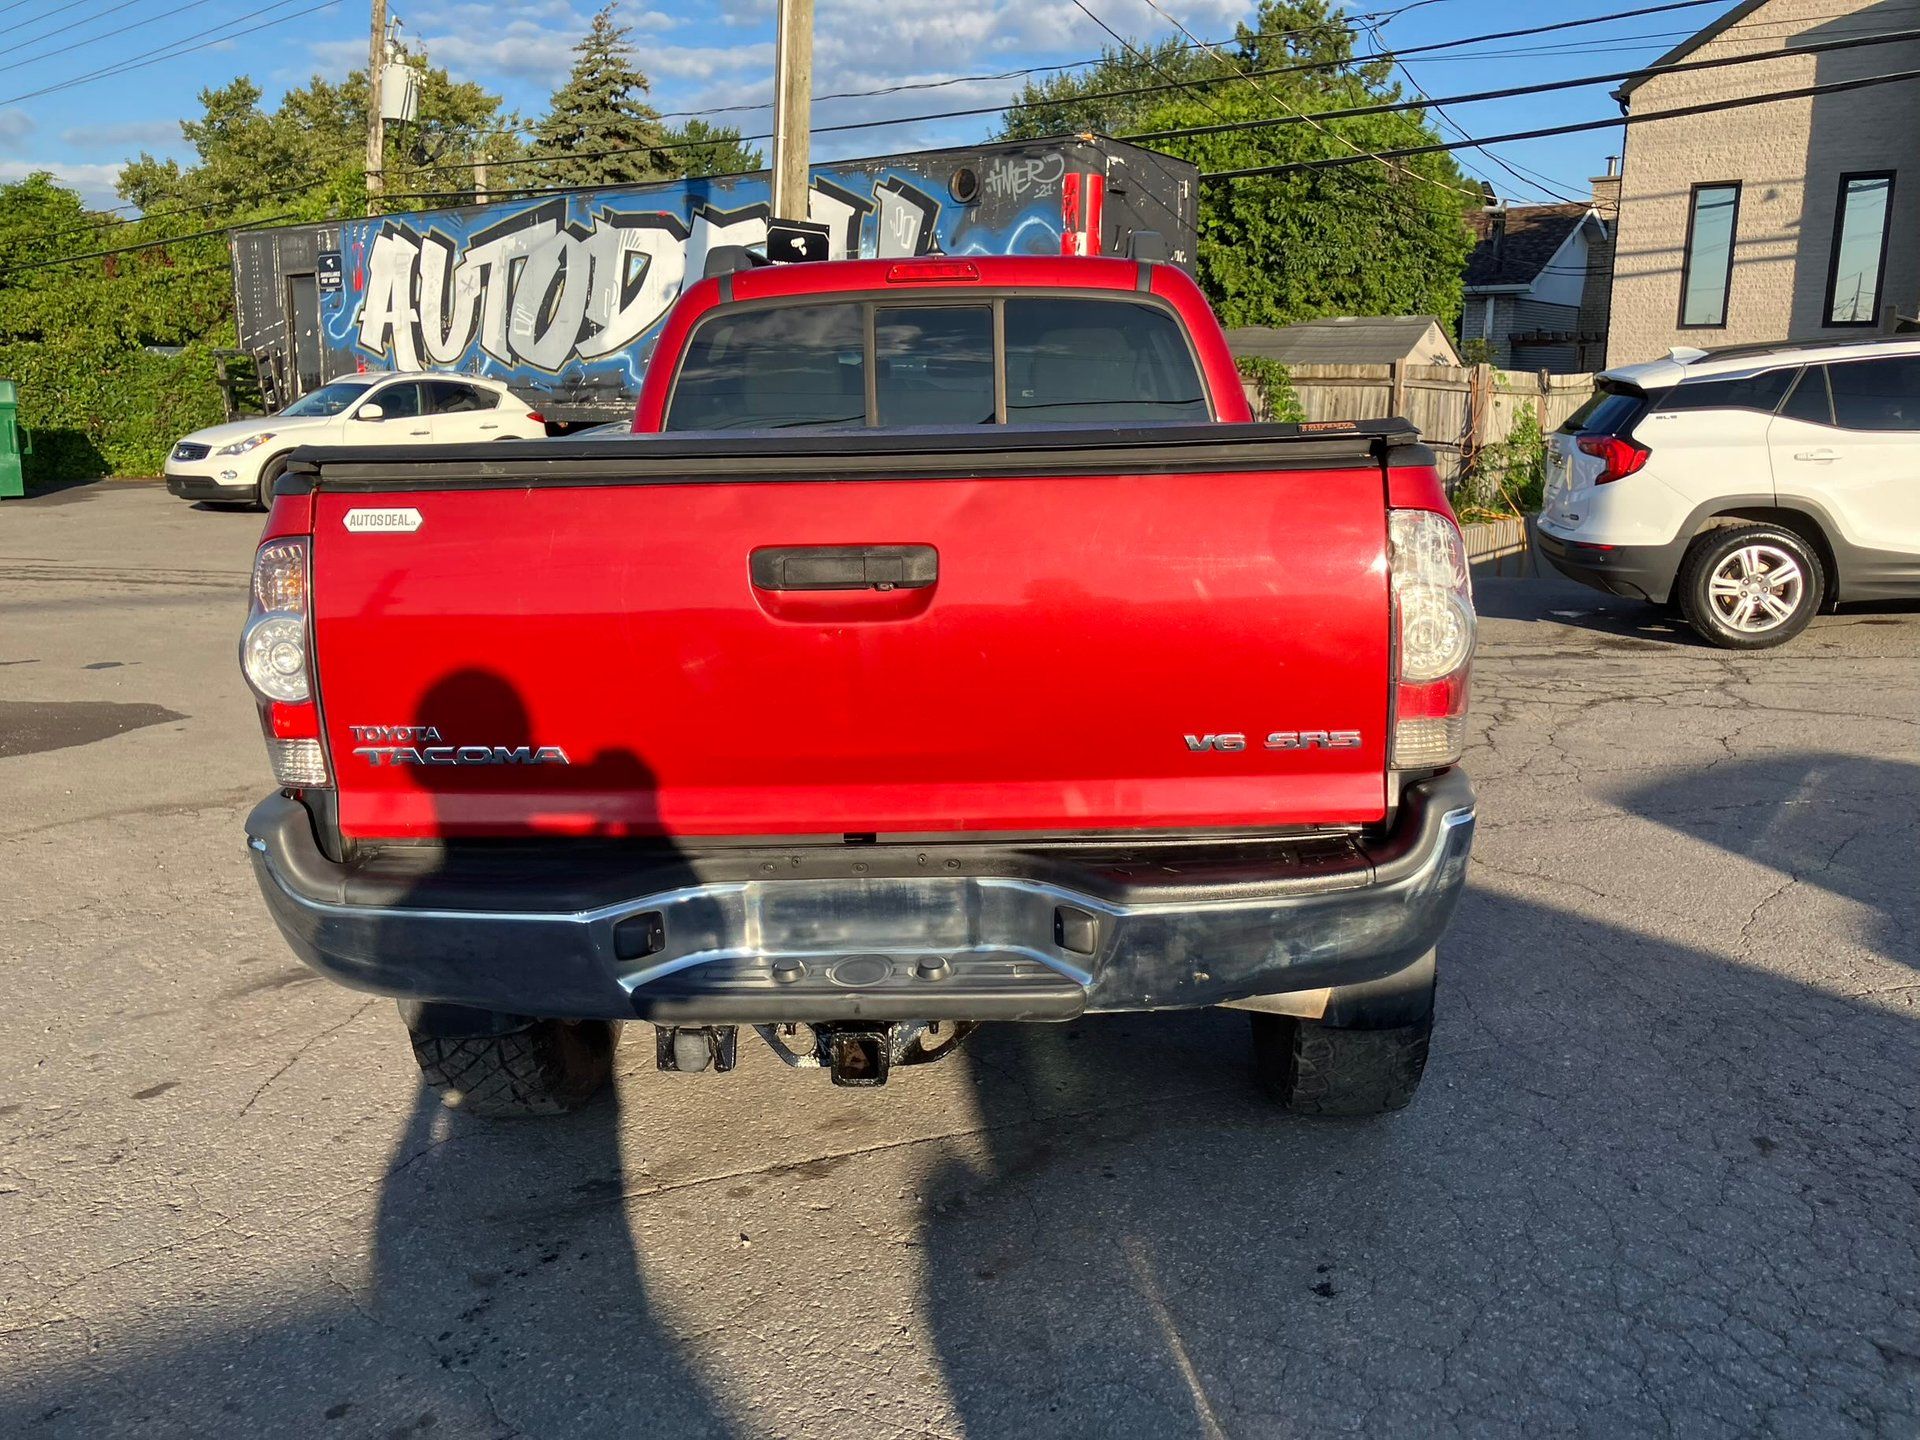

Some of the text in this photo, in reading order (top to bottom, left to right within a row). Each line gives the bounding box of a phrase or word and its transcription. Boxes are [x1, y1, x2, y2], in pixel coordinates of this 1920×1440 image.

[350, 726, 442, 742] TOYOTA
[1184, 731, 1361, 752] V6 SR5
[353, 746, 570, 766] TACOMA
